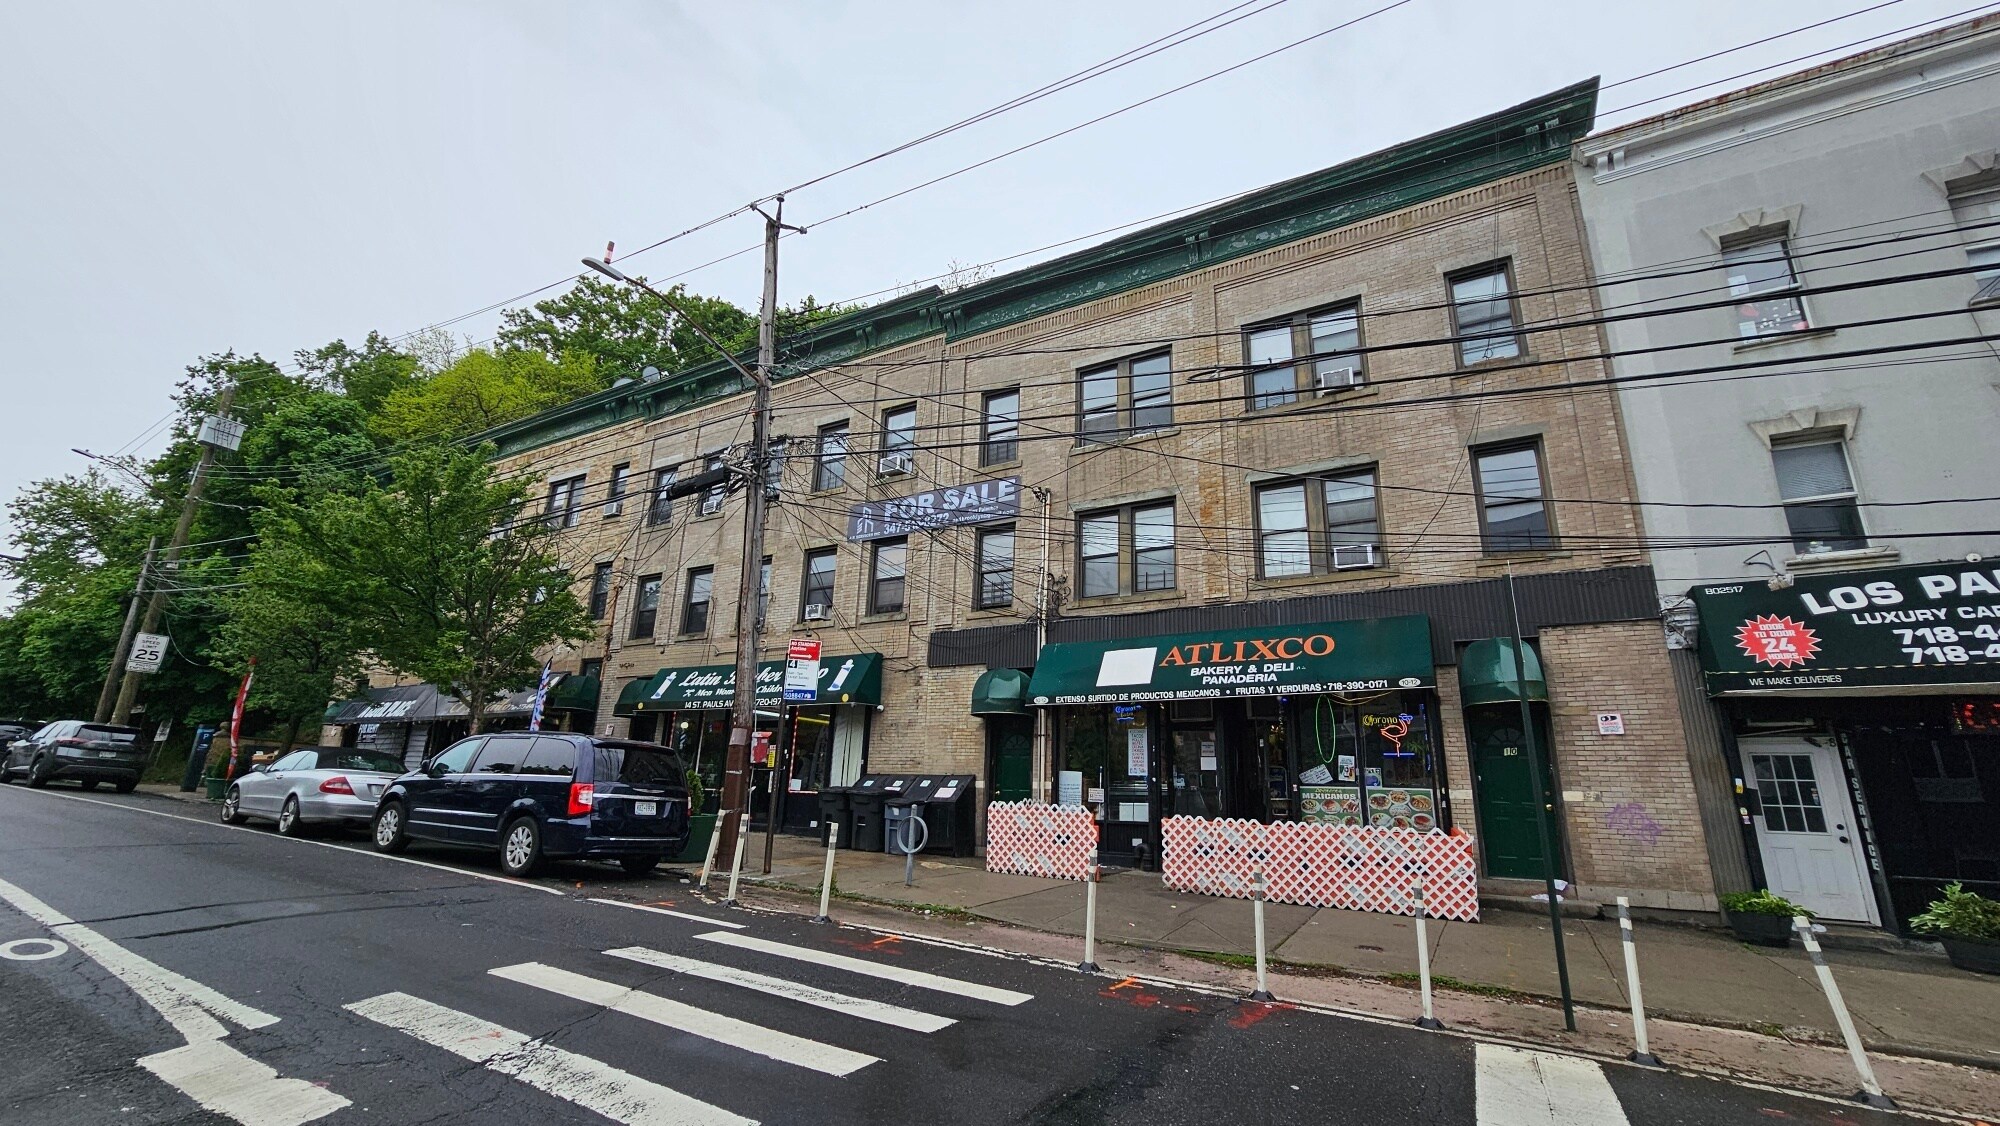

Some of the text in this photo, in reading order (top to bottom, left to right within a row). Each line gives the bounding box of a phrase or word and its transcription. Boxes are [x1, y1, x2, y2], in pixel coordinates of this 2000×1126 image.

[884, 494, 935, 522] FOR
[943, 478, 1016, 510] SALE
[1801, 569, 2000, 615] LOS PA
[1851, 608, 1947, 625] LUXURY
[1892, 624, 2000, 645] 718-4
[1159, 634, 1335, 667] ATLIXCO
[1761, 638, 1797, 653] 24
[134, 649, 160, 661] 25
[790, 659, 797, 668] 4
[1190, 663, 1295, 677] BAKERY & DELI
[678, 671, 722, 687] Latin
[1202, 673, 1278, 685] PANADERIA
[1749, 675, 1842, 686] WE MAKE DELIVERIES
[694, 684, 783, 697] Men Wom Childr
[1055, 695, 1086, 703] EXTENSO
[1087, 693, 1117, 702] SURTIDO
[1119, 693, 1129, 701] DE
[1131, 691, 1174, 700] PRODUCTOS
[1176, 688, 1221, 698] MEXICANOS
[1235, 687, 1266, 696] FRUTAS
[1276, 683, 1322, 693] VERDURAS
[1327, 679, 1388, 691] 718-390-0171
[684, 697, 782, 709] 14 ST. PAULS AV 720-197
[1363, 714, 1398, 726] Corona
[1504, 748, 1518, 756] 10
[1841, 733, 1855, 770] CAR
[1302, 792, 1356, 800] MEXICANOS
[1852, 777, 1880, 871] SERVICE
